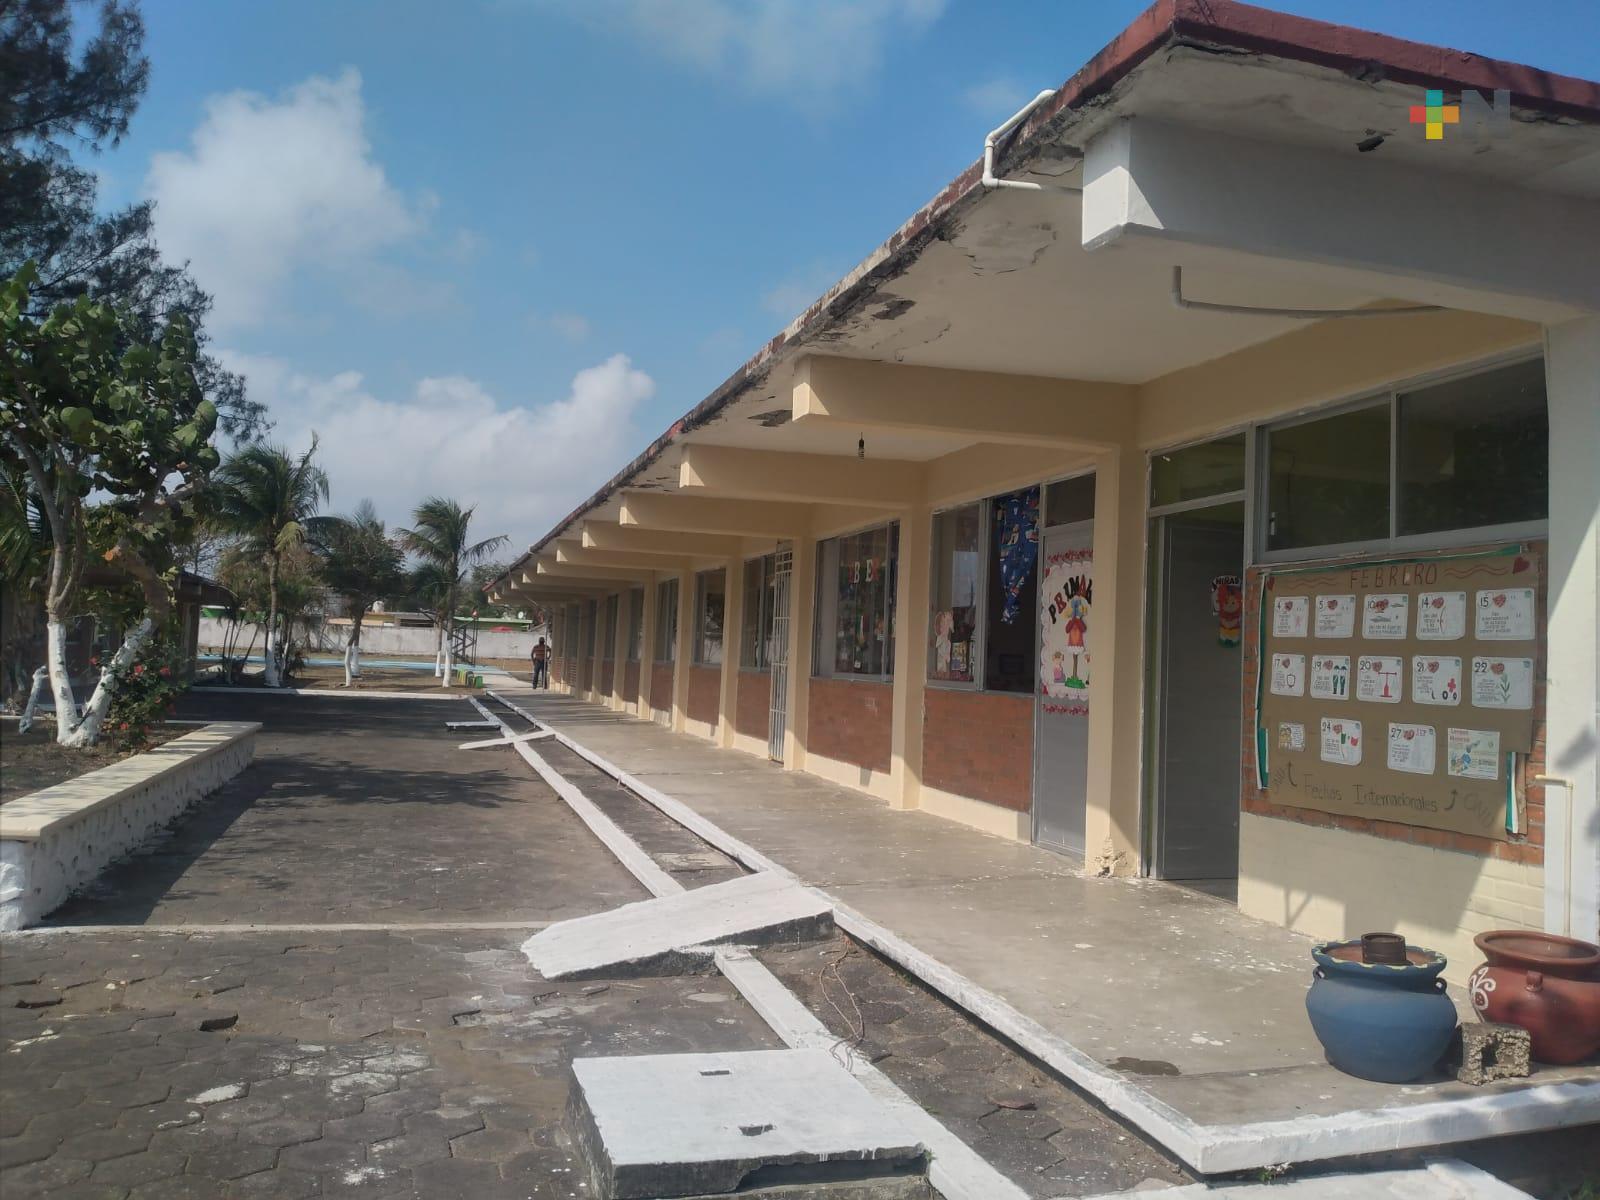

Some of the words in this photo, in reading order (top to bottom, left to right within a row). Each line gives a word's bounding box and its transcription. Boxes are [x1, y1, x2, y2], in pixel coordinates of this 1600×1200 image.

[1350, 563, 1439, 589] FEBRERO
[1319, 600, 1324, 610] 5
[1421, 597, 1430, 608] 14
[1480, 596, 1489, 607] 15
[1274, 658, 1281, 668] 17
[1359, 660, 1371, 670] 20
[1474, 662, 1488, 673] 22
[1322, 721, 1331, 732] 24
[1391, 728, 1402, 739] 27
